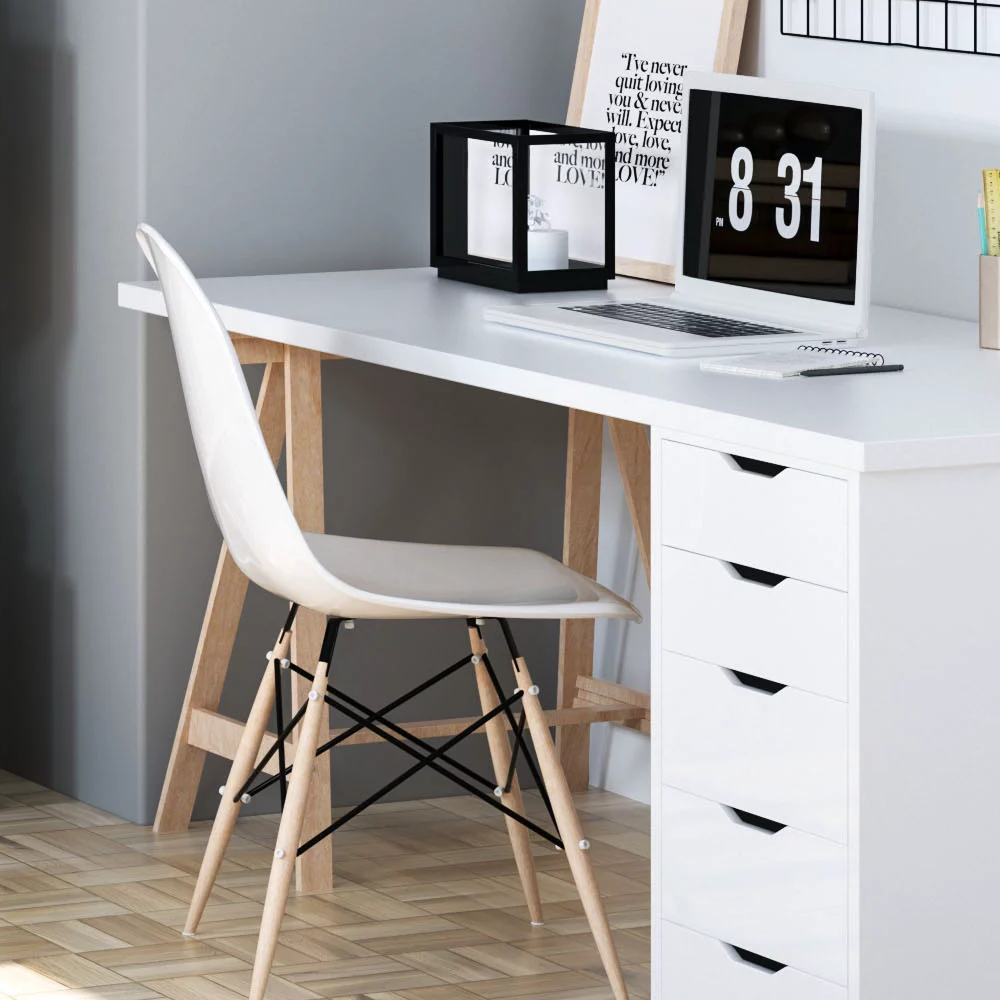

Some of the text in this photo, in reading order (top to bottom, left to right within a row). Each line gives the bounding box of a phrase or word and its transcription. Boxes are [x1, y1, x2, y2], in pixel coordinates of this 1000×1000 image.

[650, 62, 688, 76] never
[615, 74, 683, 102] quit loving
[607, 94, 631, 110] you
[634, 92, 648, 110] &
[606, 109, 682, 136] will. Expect
[642, 130, 671, 154] love,
[554, 150, 577, 166] and
[615, 148, 670, 170] nd more
[615, 165, 665, 187] OVE!”
[728, 146, 822, 242] 8 31
[716, 216, 724, 227] PM
